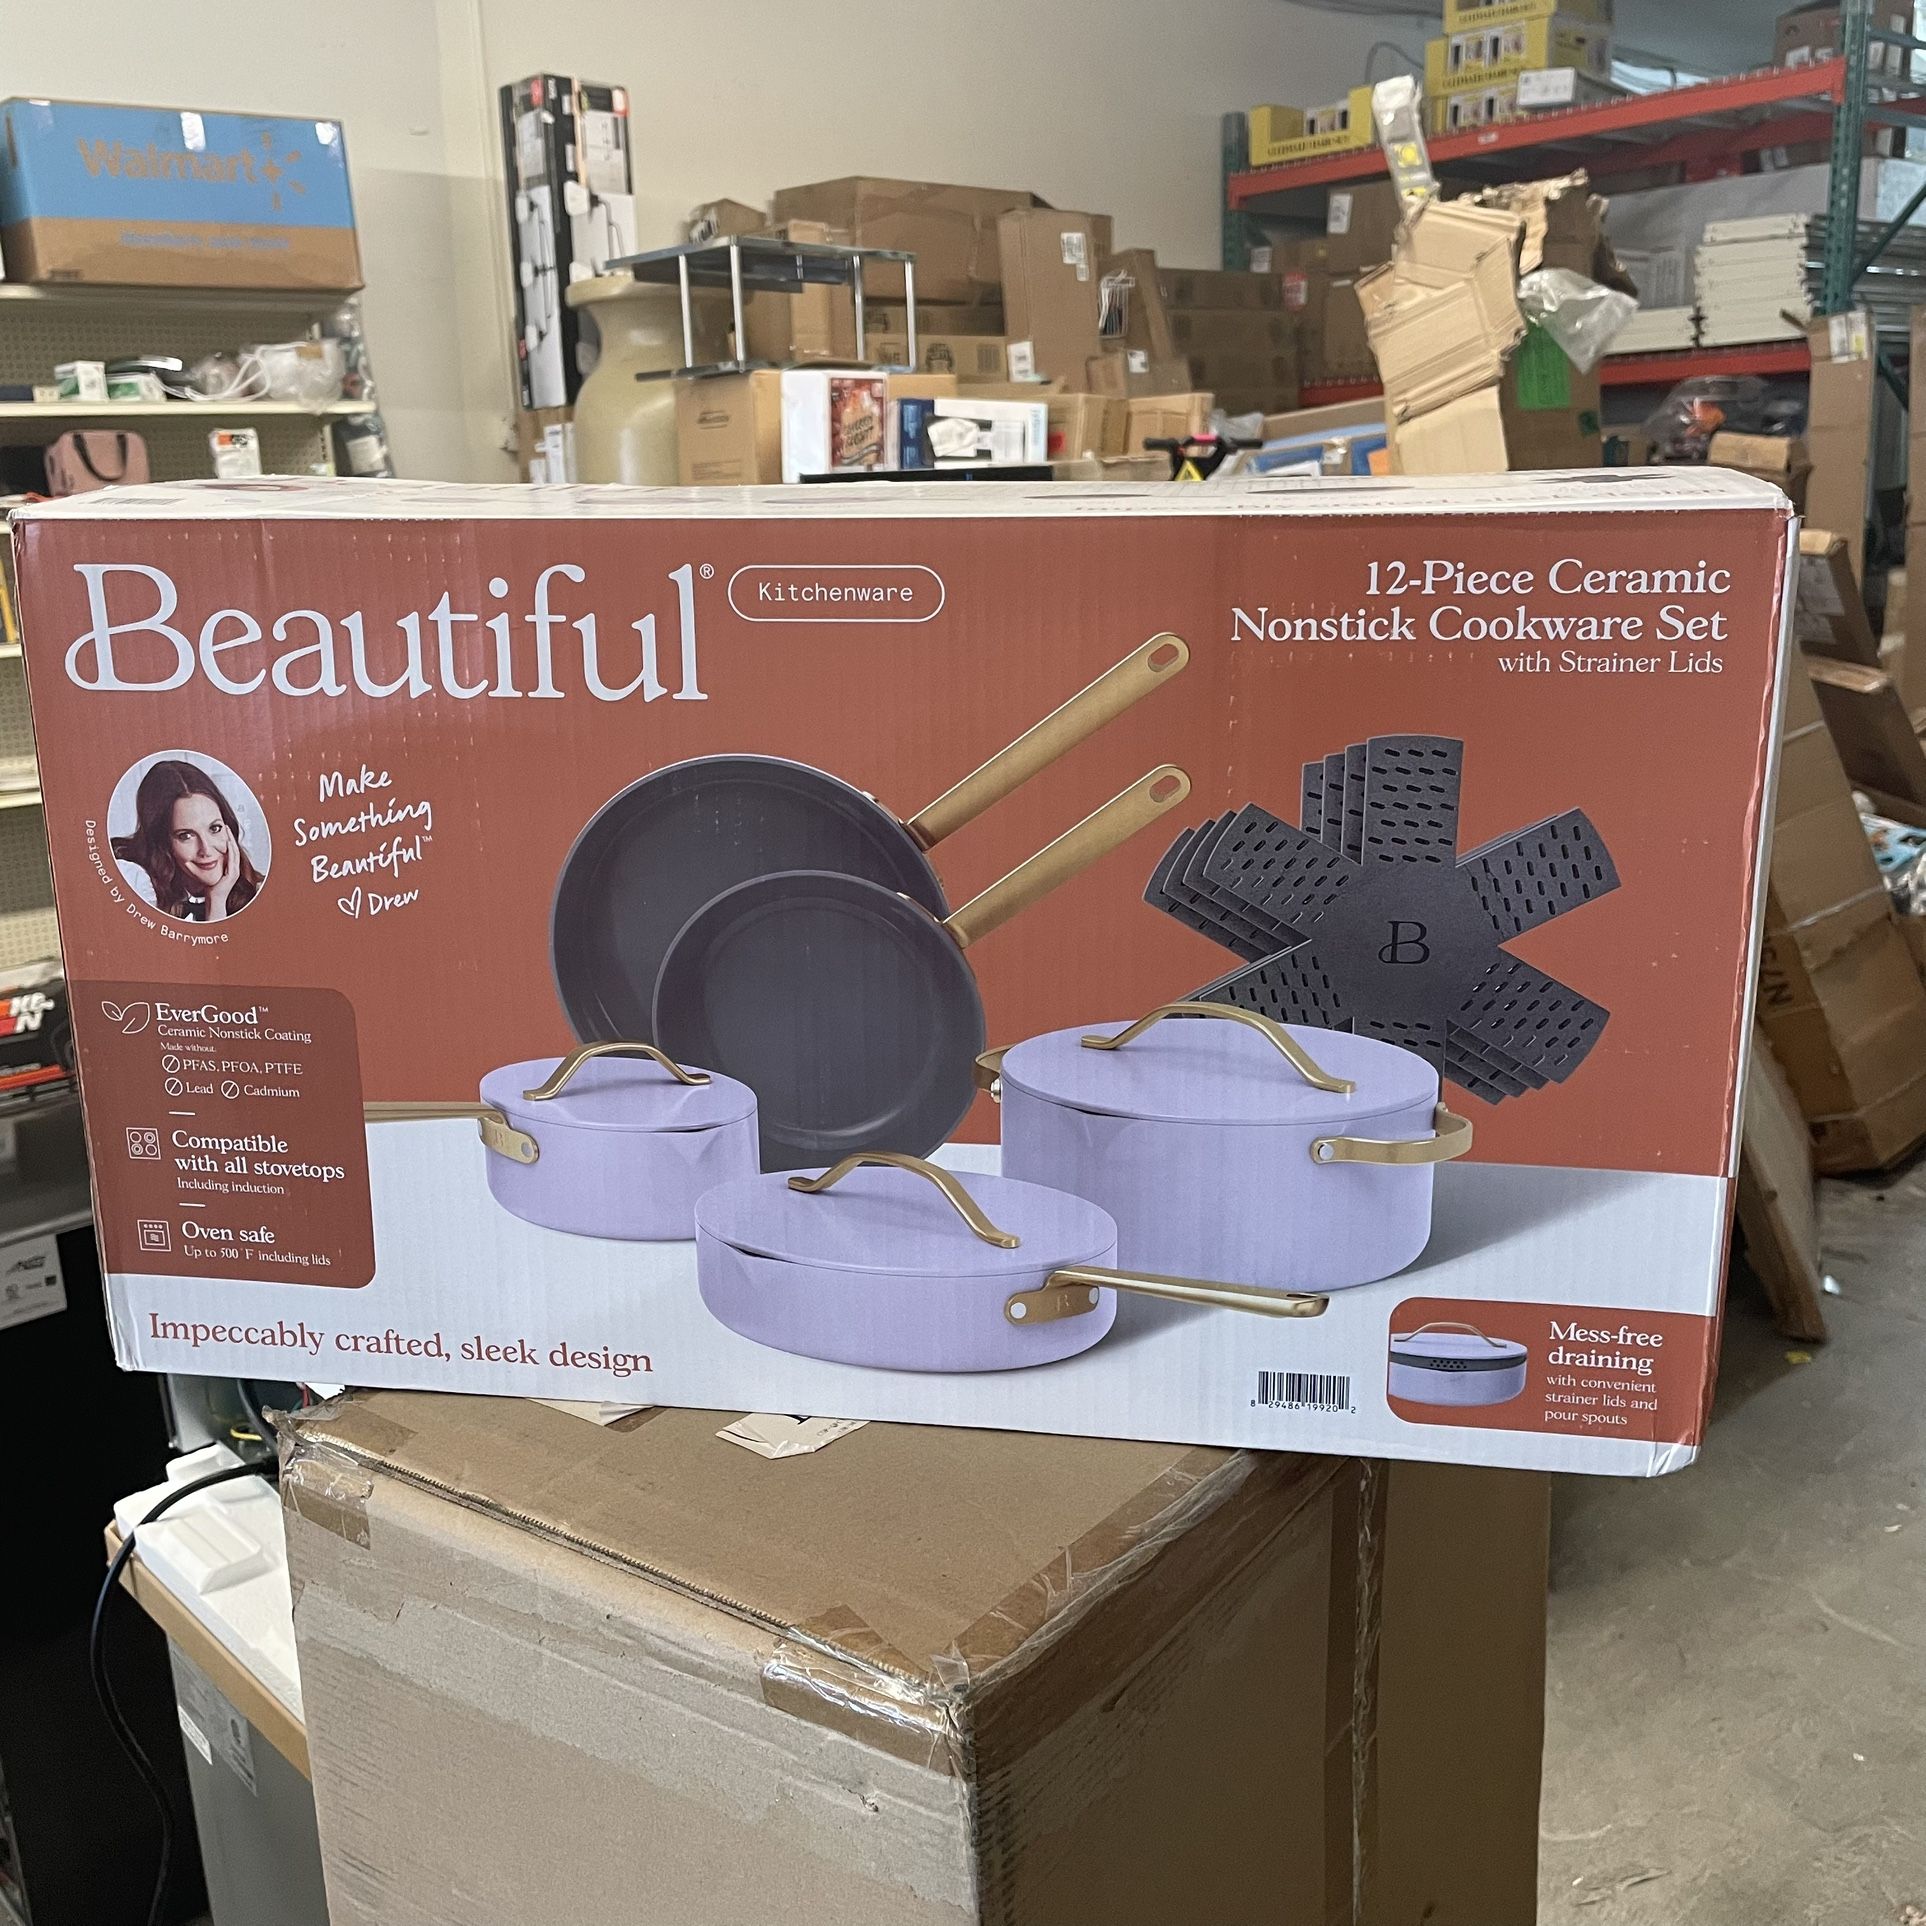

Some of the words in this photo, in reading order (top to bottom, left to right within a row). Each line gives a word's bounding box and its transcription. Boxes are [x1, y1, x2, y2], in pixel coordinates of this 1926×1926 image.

[77, 137, 258, 184] Walmart
[1366, 560, 1535, 595] 12-Piece
[1547, 558, 1731, 595] Ceramic
[758, 582, 914, 602] Kitchenware
[1231, 606, 1417, 643] Nonstick
[1428, 605, 1644, 643] Cookware
[1656, 605, 1728, 643] Set
[1498, 651, 1551, 675] with
[1558, 650, 1661, 675] Strainer
[1667, 650, 1724, 675] Lids
[319, 763, 393, 803] Make
[293, 797, 433, 847] Something
[85, 819, 114, 884] Designed
[109, 886, 126, 904] by
[126, 903, 157, 930] Drew
[160, 924, 230, 948] Barrymore
[367, 889, 420, 916] Drew
[156, 1024, 207, 1040] Ceramic
[208, 1026, 263, 1041] Nonstick
[264, 1028, 313, 1045] Coating
[264, 1062, 304, 1076] PTFE
[185, 1081, 214, 1095] Lead
[243, 1084, 301, 1098] Cadmium
[171, 1129, 289, 1155] Compatible
[174, 1154, 219, 1174] with
[224, 1156, 249, 1175] all
[253, 1161, 346, 1183] stovetops
[177, 1177, 230, 1194] Including
[231, 1180, 285, 1195] induction
[181, 1220, 234, 1242] Oven
[239, 1225, 276, 1244] safe
[184, 1244, 202, 1259] Up
[205, 1248, 217, 1258] to
[258, 1250, 310, 1266] including
[311, 1253, 332, 1266] lids
[149, 1312, 326, 1357] Impeccably
[335, 1327, 452, 1363] crafted,
[460, 1333, 541, 1367] sleek
[548, 1341, 655, 1379] design
[1549, 1320, 1664, 1348] Mess-free
[1547, 1345, 1655, 1376] draining
[1546, 1374, 1576, 1387] with
[1580, 1379, 1657, 1394] convenient
[1250, 1399, 1256, 1408] 8
[1268, 1401, 1301, 1411] 29486
[1306, 1403, 1339, 1413] 19920
[1350, 1406, 1357, 1414] 2
[1545, 1392, 1599, 1406] strainer
[1602, 1394, 1627, 1408] lids
[1630, 1398, 1658, 1411] and
[1544, 1410, 1579, 1422] pour
[1581, 1412, 1628, 1425] spouts
